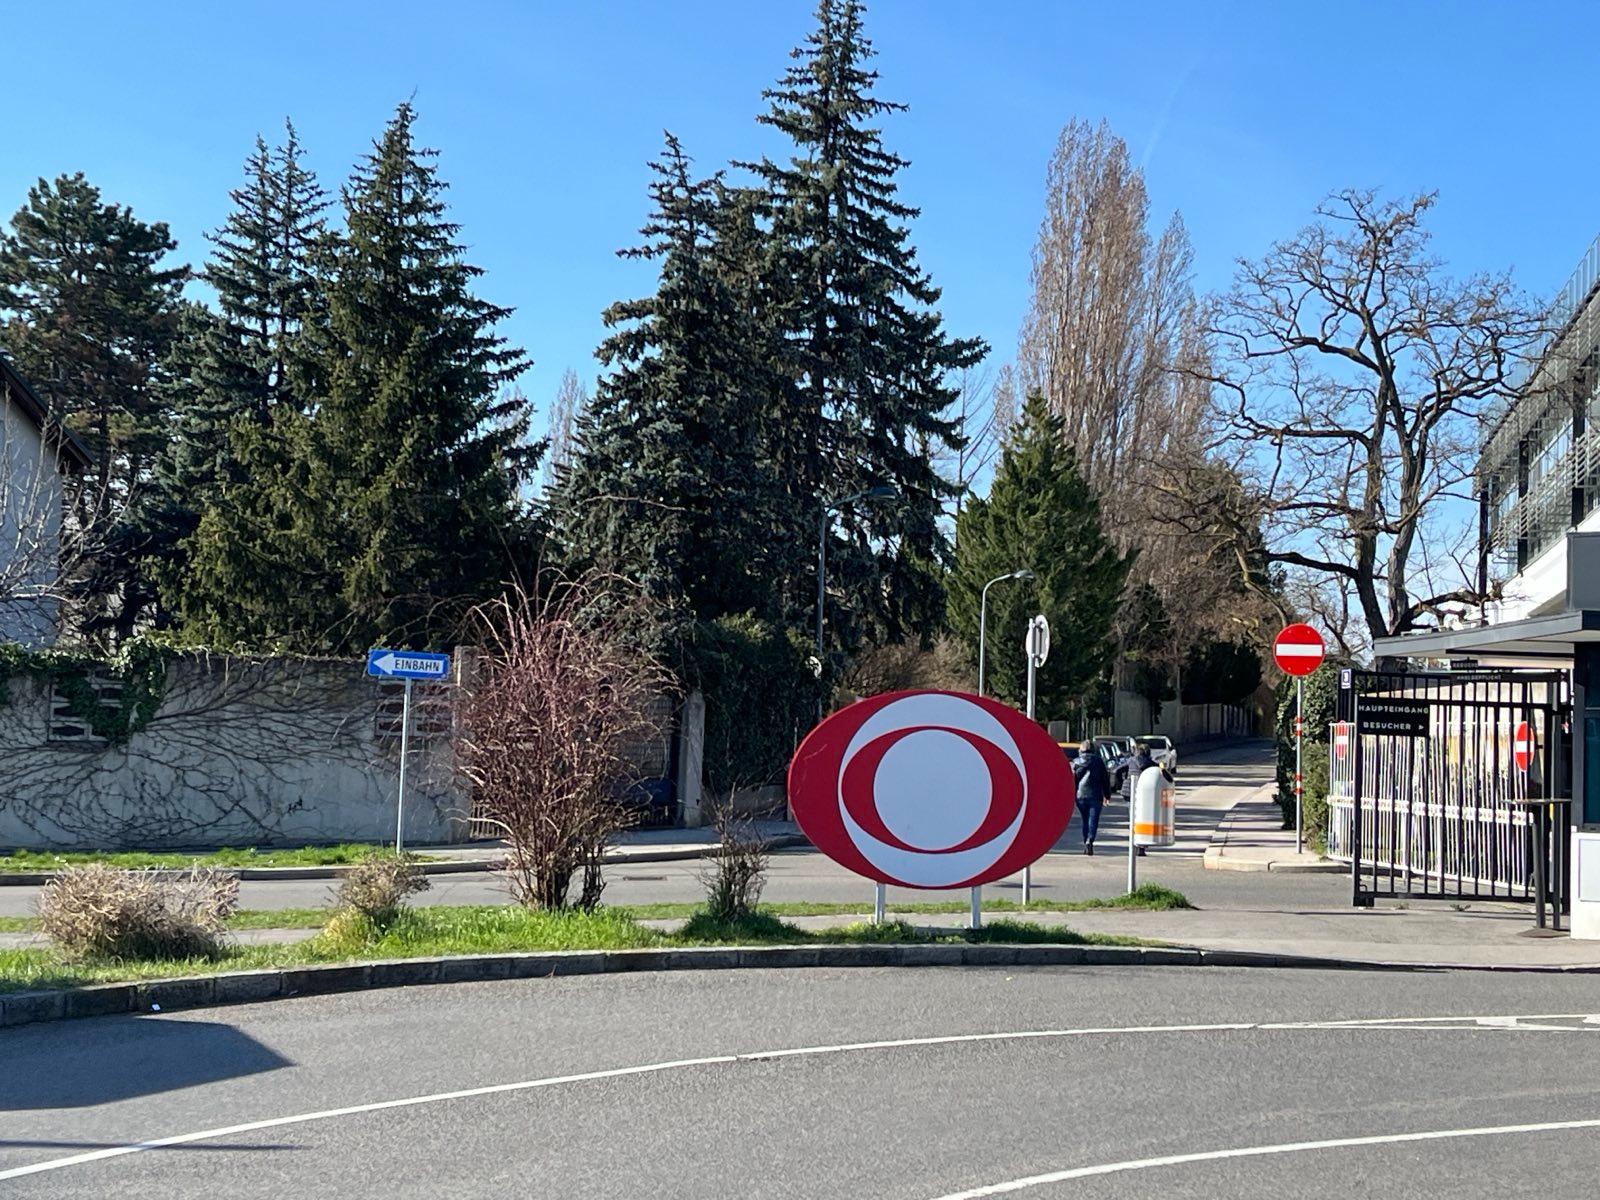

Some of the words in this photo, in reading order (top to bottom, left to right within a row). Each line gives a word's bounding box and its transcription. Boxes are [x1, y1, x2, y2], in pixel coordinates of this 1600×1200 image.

[395, 659, 440, 672] EINBAHN
[1358, 704, 1429, 714] HAUPTEINGANG
[1362, 721, 1412, 730] BESUCHER
